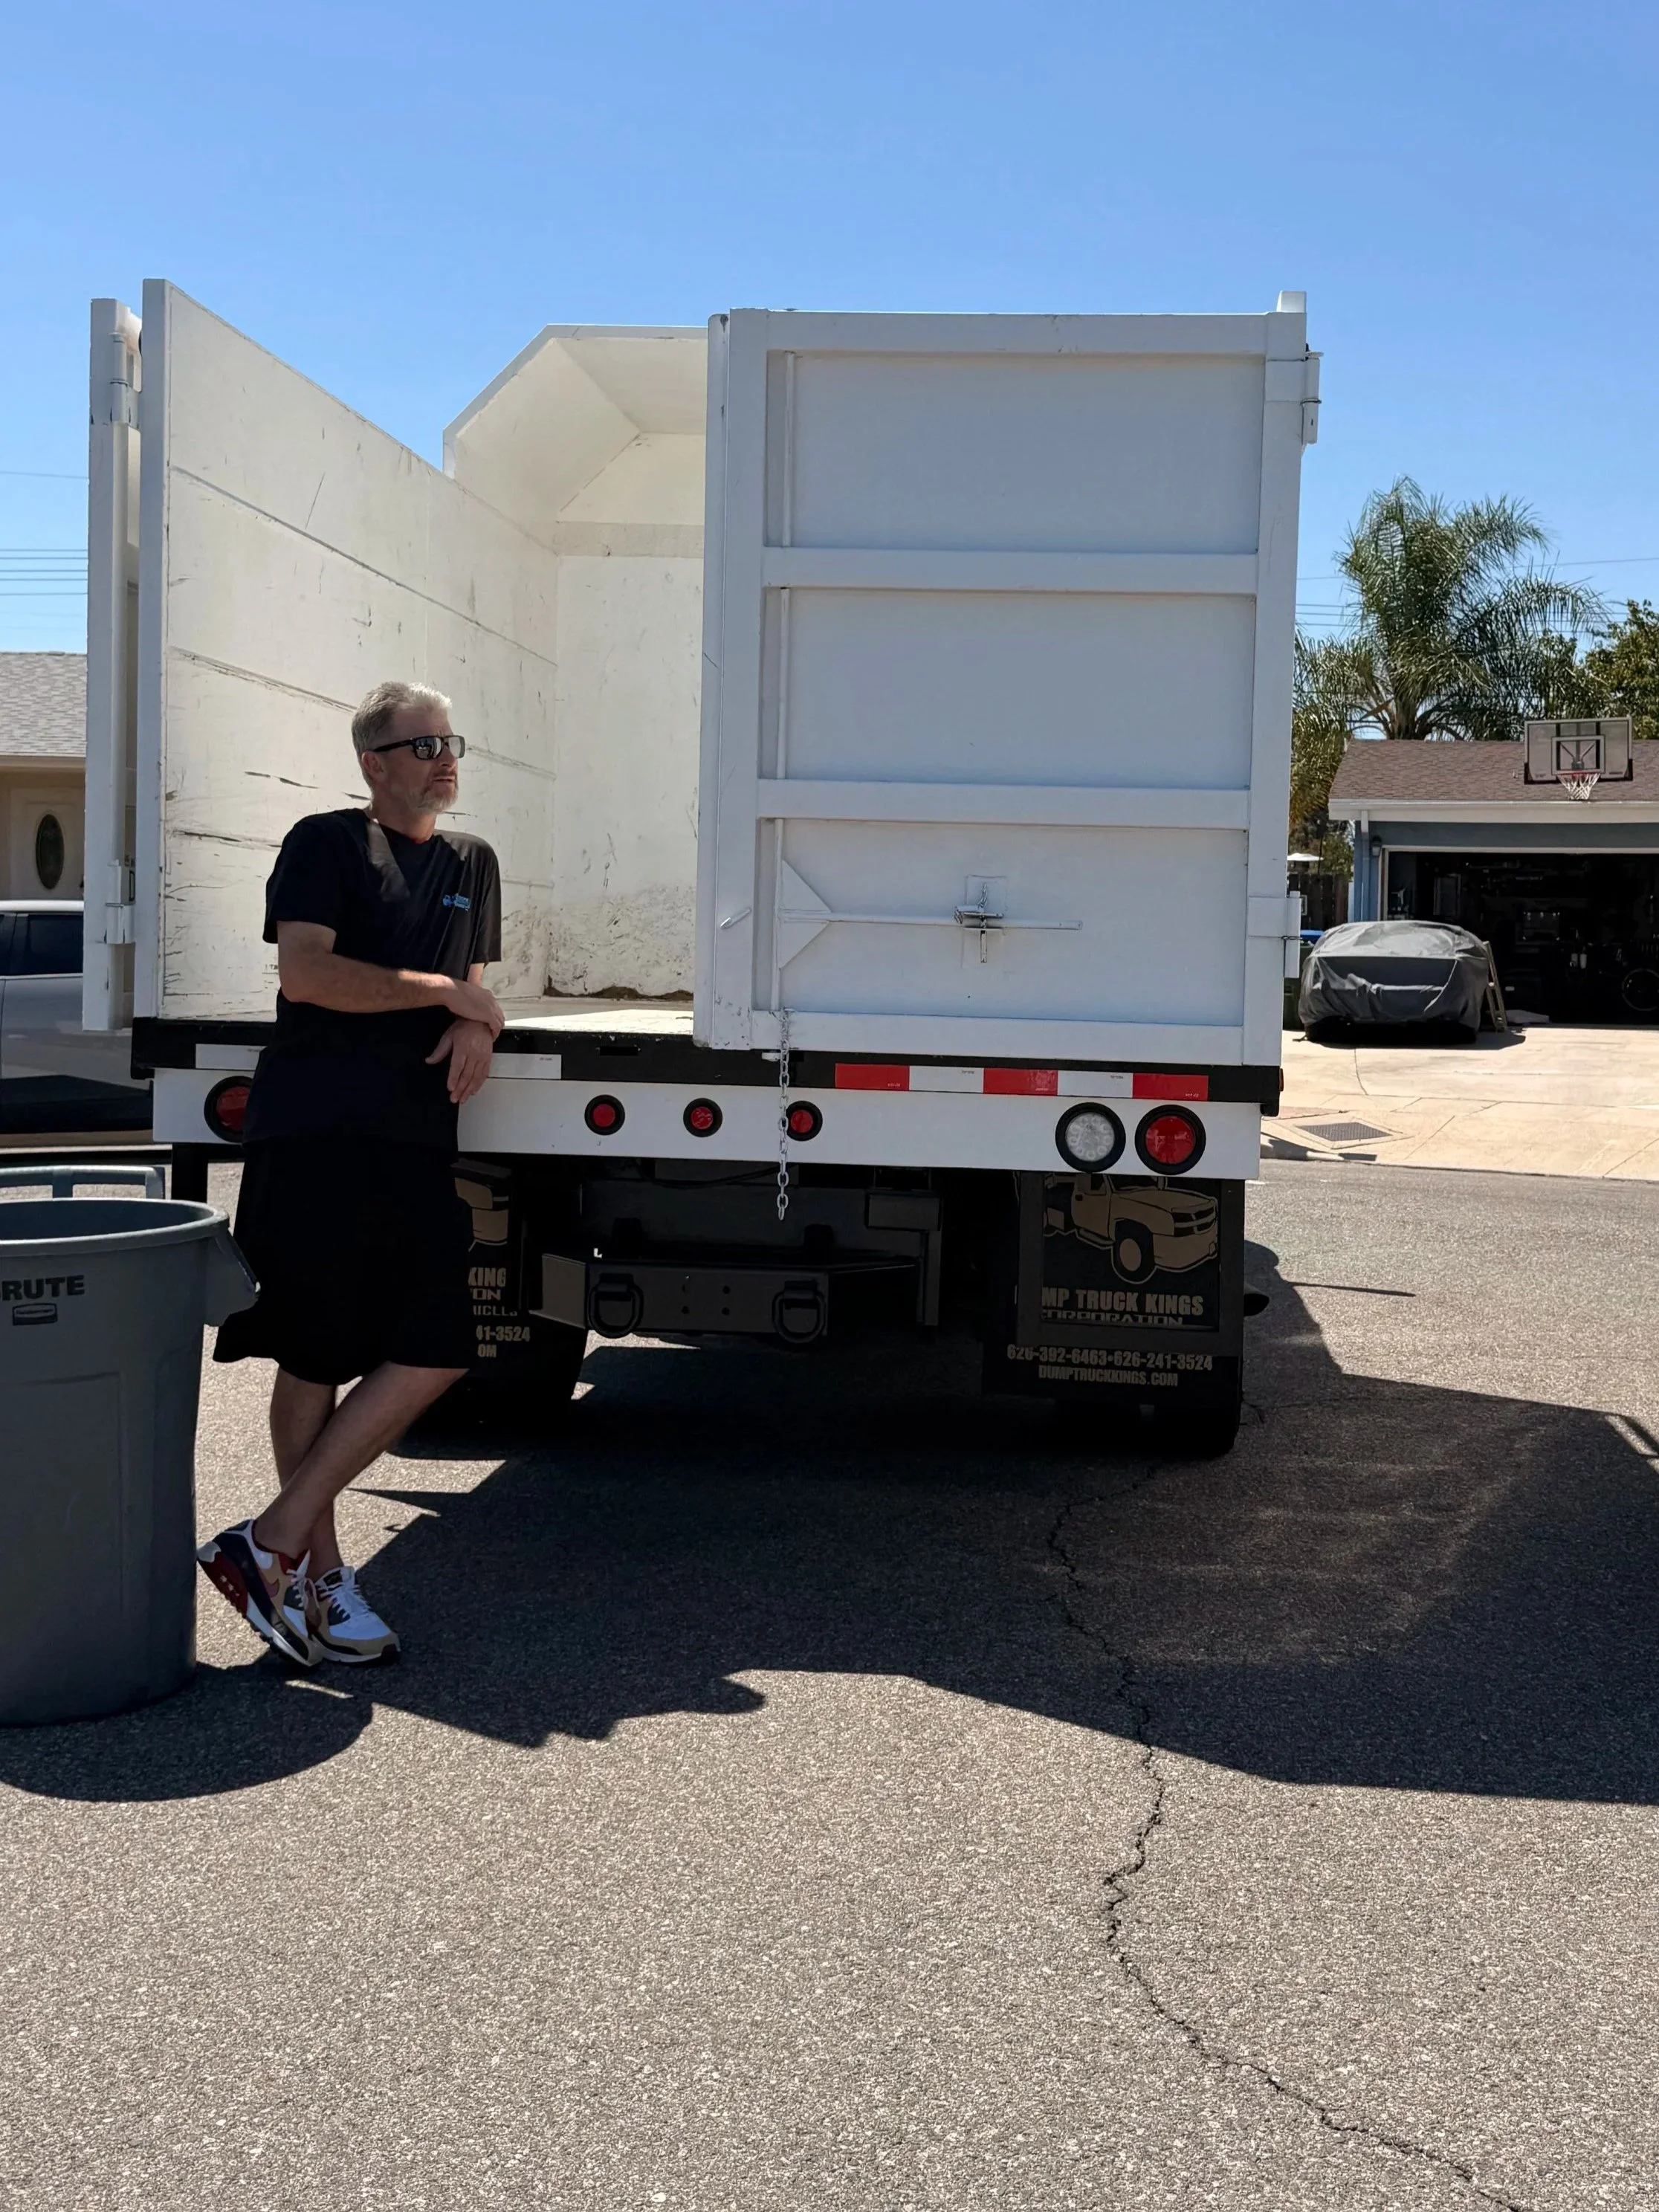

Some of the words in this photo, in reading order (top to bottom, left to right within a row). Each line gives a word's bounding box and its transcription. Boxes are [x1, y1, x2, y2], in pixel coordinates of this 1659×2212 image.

[1, 1275, 85, 1301] RUTE
[468, 1266, 507, 1287] KING
[1041, 1287, 1070, 1308] MP
[1076, 1288, 1139, 1313] TRUCK
[1145, 1293, 1204, 1316] KINGS
[476, 1324, 531, 1342] 41-3524
[1038, 1364, 1179, 1388] DUMPTRUCKKINGS.COM
